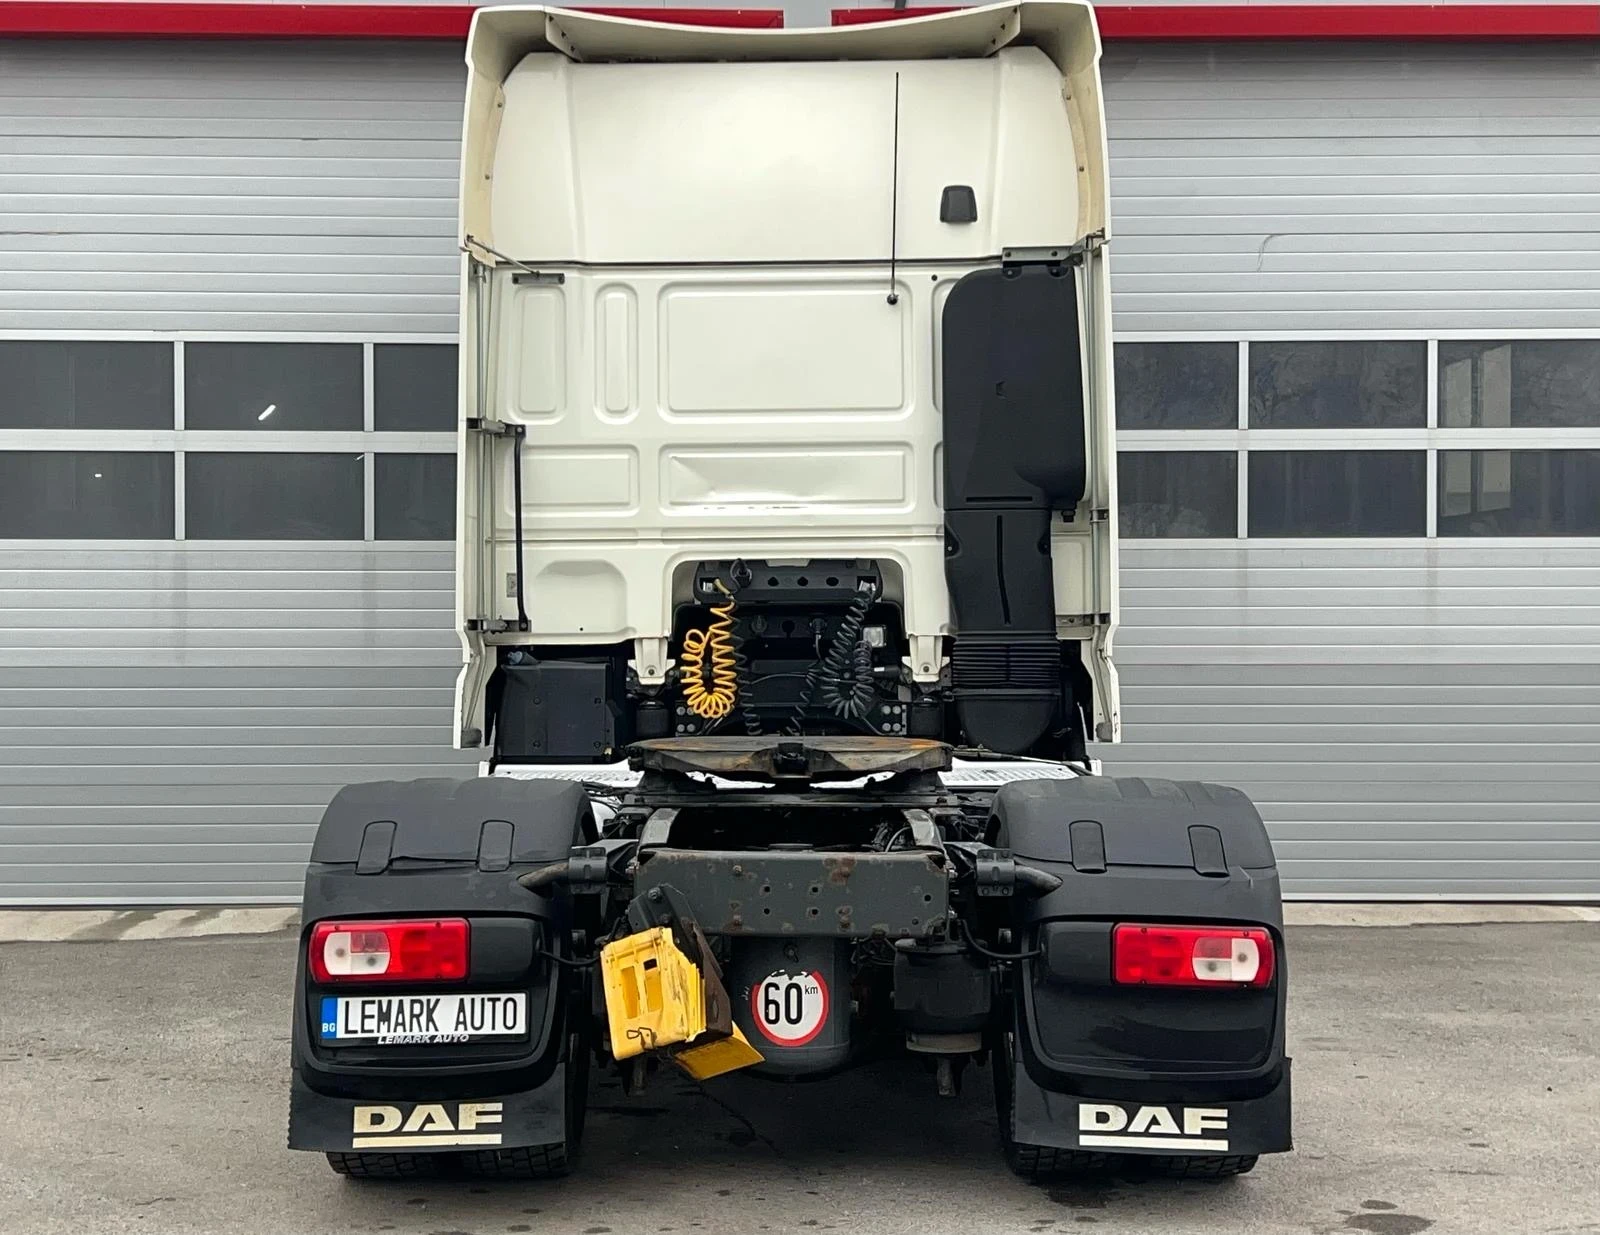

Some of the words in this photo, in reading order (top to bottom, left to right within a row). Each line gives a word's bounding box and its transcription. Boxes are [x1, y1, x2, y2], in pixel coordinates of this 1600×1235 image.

[344, 998, 441, 1034] LEMARK
[454, 997, 518, 1032] AUTO
[764, 982, 803, 1025] 60
[804, 985, 819, 995] km
[322, 1023, 336, 1033] BG
[377, 1034, 431, 1045] LEMARK
[433, 1033, 471, 1043] AUTO
[353, 1103, 502, 1133] DAF
[1079, 1103, 1229, 1134] DAF
